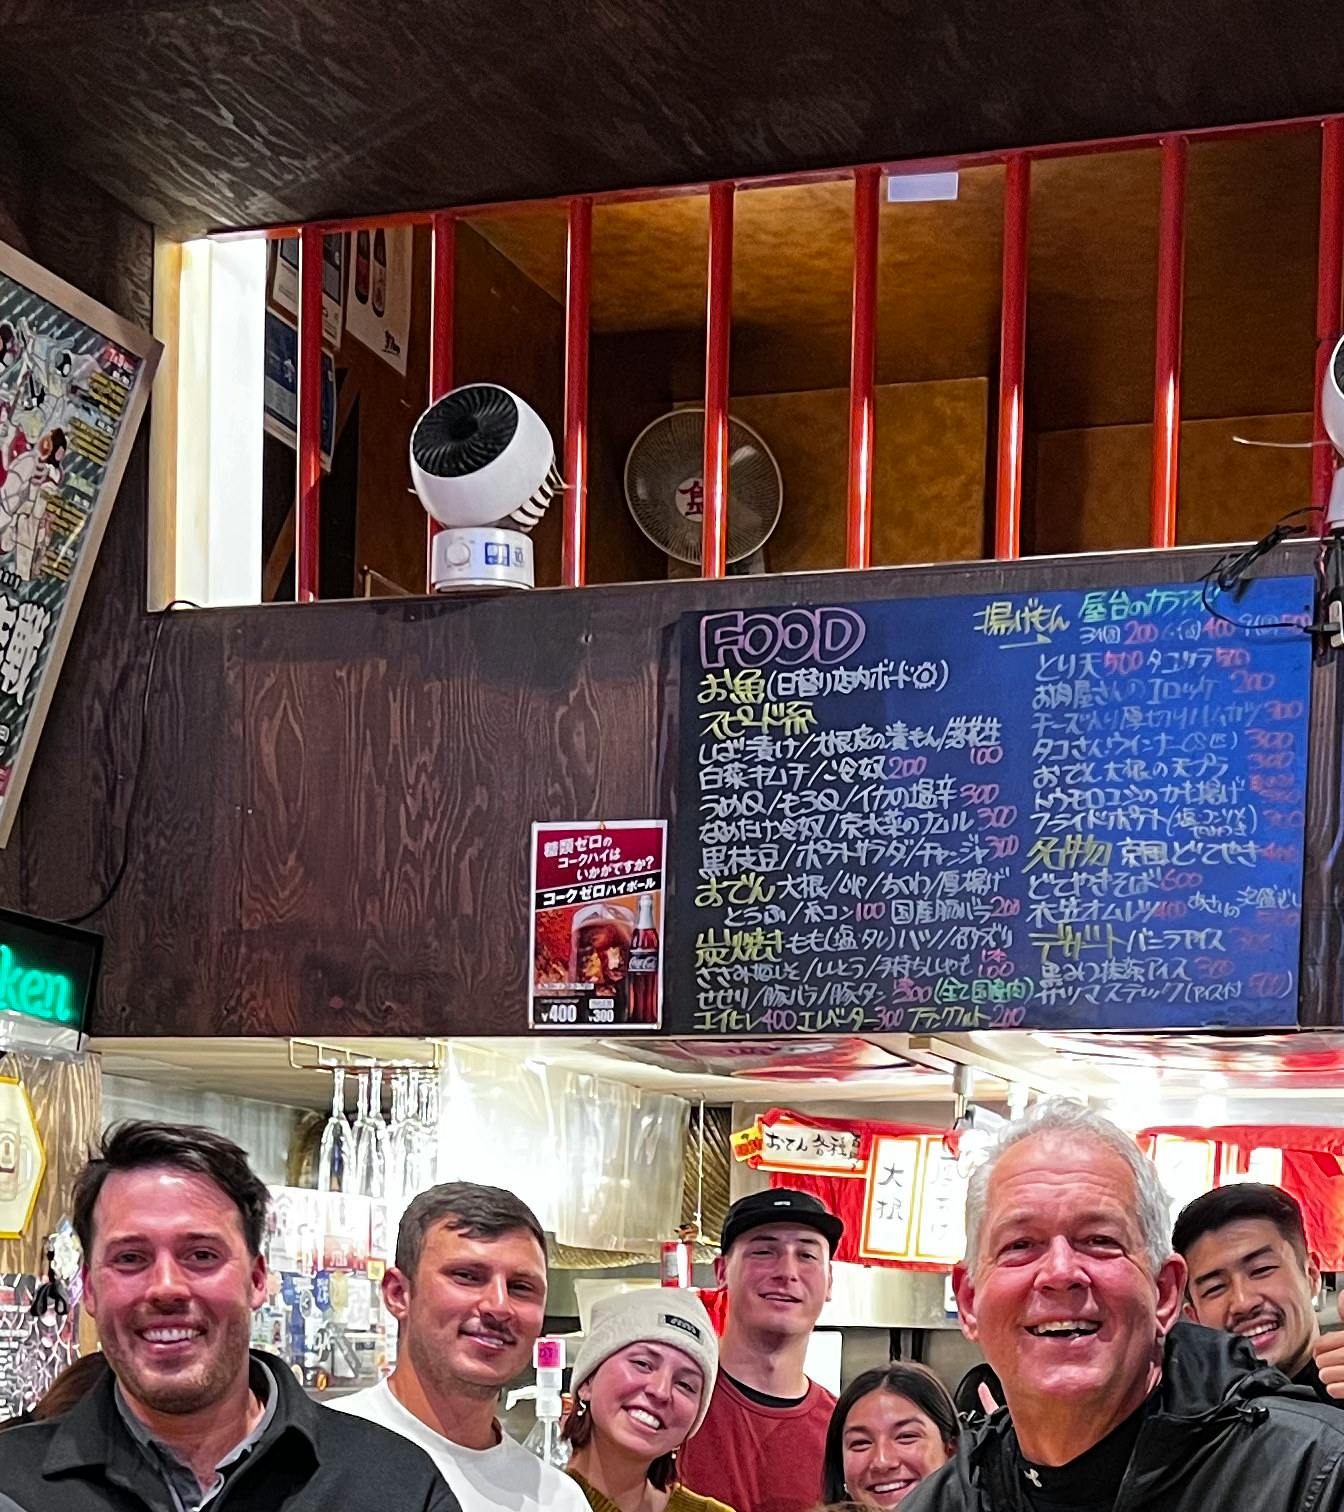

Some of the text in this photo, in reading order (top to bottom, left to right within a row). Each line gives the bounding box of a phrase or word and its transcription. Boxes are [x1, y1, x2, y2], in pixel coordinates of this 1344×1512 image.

[699, 607, 866, 668] FOOD
[889, 756, 928, 780] 200
[959, 783, 1000, 805] 300
[977, 805, 1018, 829] 300
[576, 855, 655, 881] いかがですか?
[695, 872, 777, 907] おでん
[855, 902, 885, 922] 100
[762, 1009, 797, 1031] 400
[874, 1008, 905, 1031] 300
